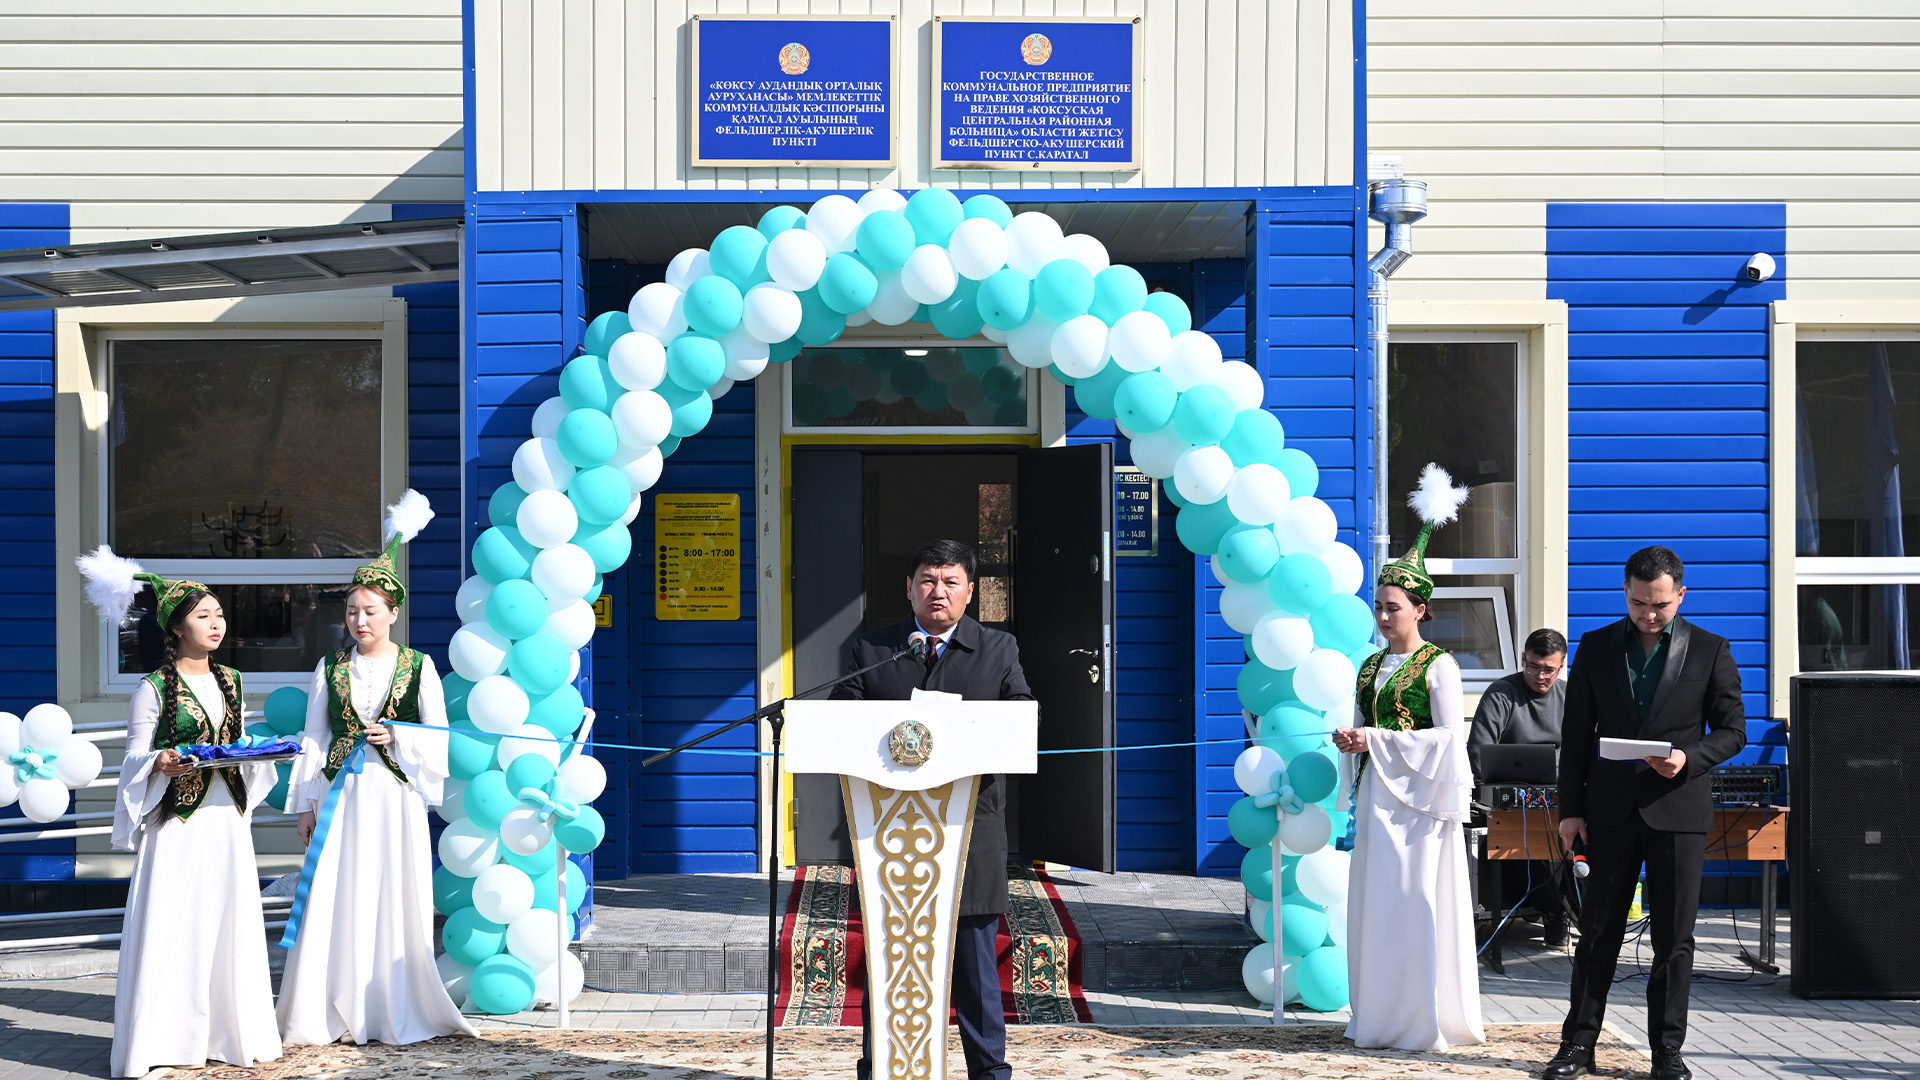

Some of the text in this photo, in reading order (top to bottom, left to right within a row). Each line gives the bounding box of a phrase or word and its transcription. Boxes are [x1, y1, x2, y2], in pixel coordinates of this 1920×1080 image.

[980, 72, 1094, 81] ГОСУДАРСТВЕННОЕ
[710, 81, 882, 91] «КӨКСУ АУДАНДЫҚ ОРТАЛЫҚ
[943, 83, 1131, 93] КОММУНАЛЬНОЕ ПРЕДПРИЯТИЕ
[708, 92, 881, 101] АУРУХАНАСЫ» МЕМЛЕКЕТТІК
[954, 94, 1120, 103] НА ПРАВЕ ХОЗЯЙСТВЕННОГО
[705, 104, 884, 113] КОММУНАЛДЫҚ КӘСІПОРЫНЫ
[970, 105, 1104, 114] ВЕДЕНИЯ «КОКСУСКАЯ
[732, 115, 858, 124] ҚАРАТАЛ АУЫЛЫНЫҢ
[962, 116, 1111, 125] ЦЕНТРАЛЬНАЯ РАЙОННАЯ
[716, 126, 874, 135] ФЕЛЬДШЕРЛІК-АКУШЕРЛІК
[950, 128, 1124, 137] БОЛЬНИЦА» ОБЛАСТИ ЖЕТІСУ
[772, 138, 817, 146] ПУНКТІ
[949, 138, 1124, 148] ФЕЛЬДШЕРСКО-АКУШЕРСКИЙ
[985, 150, 1088, 159] ПУНКТ С.КАРАТАЛ
